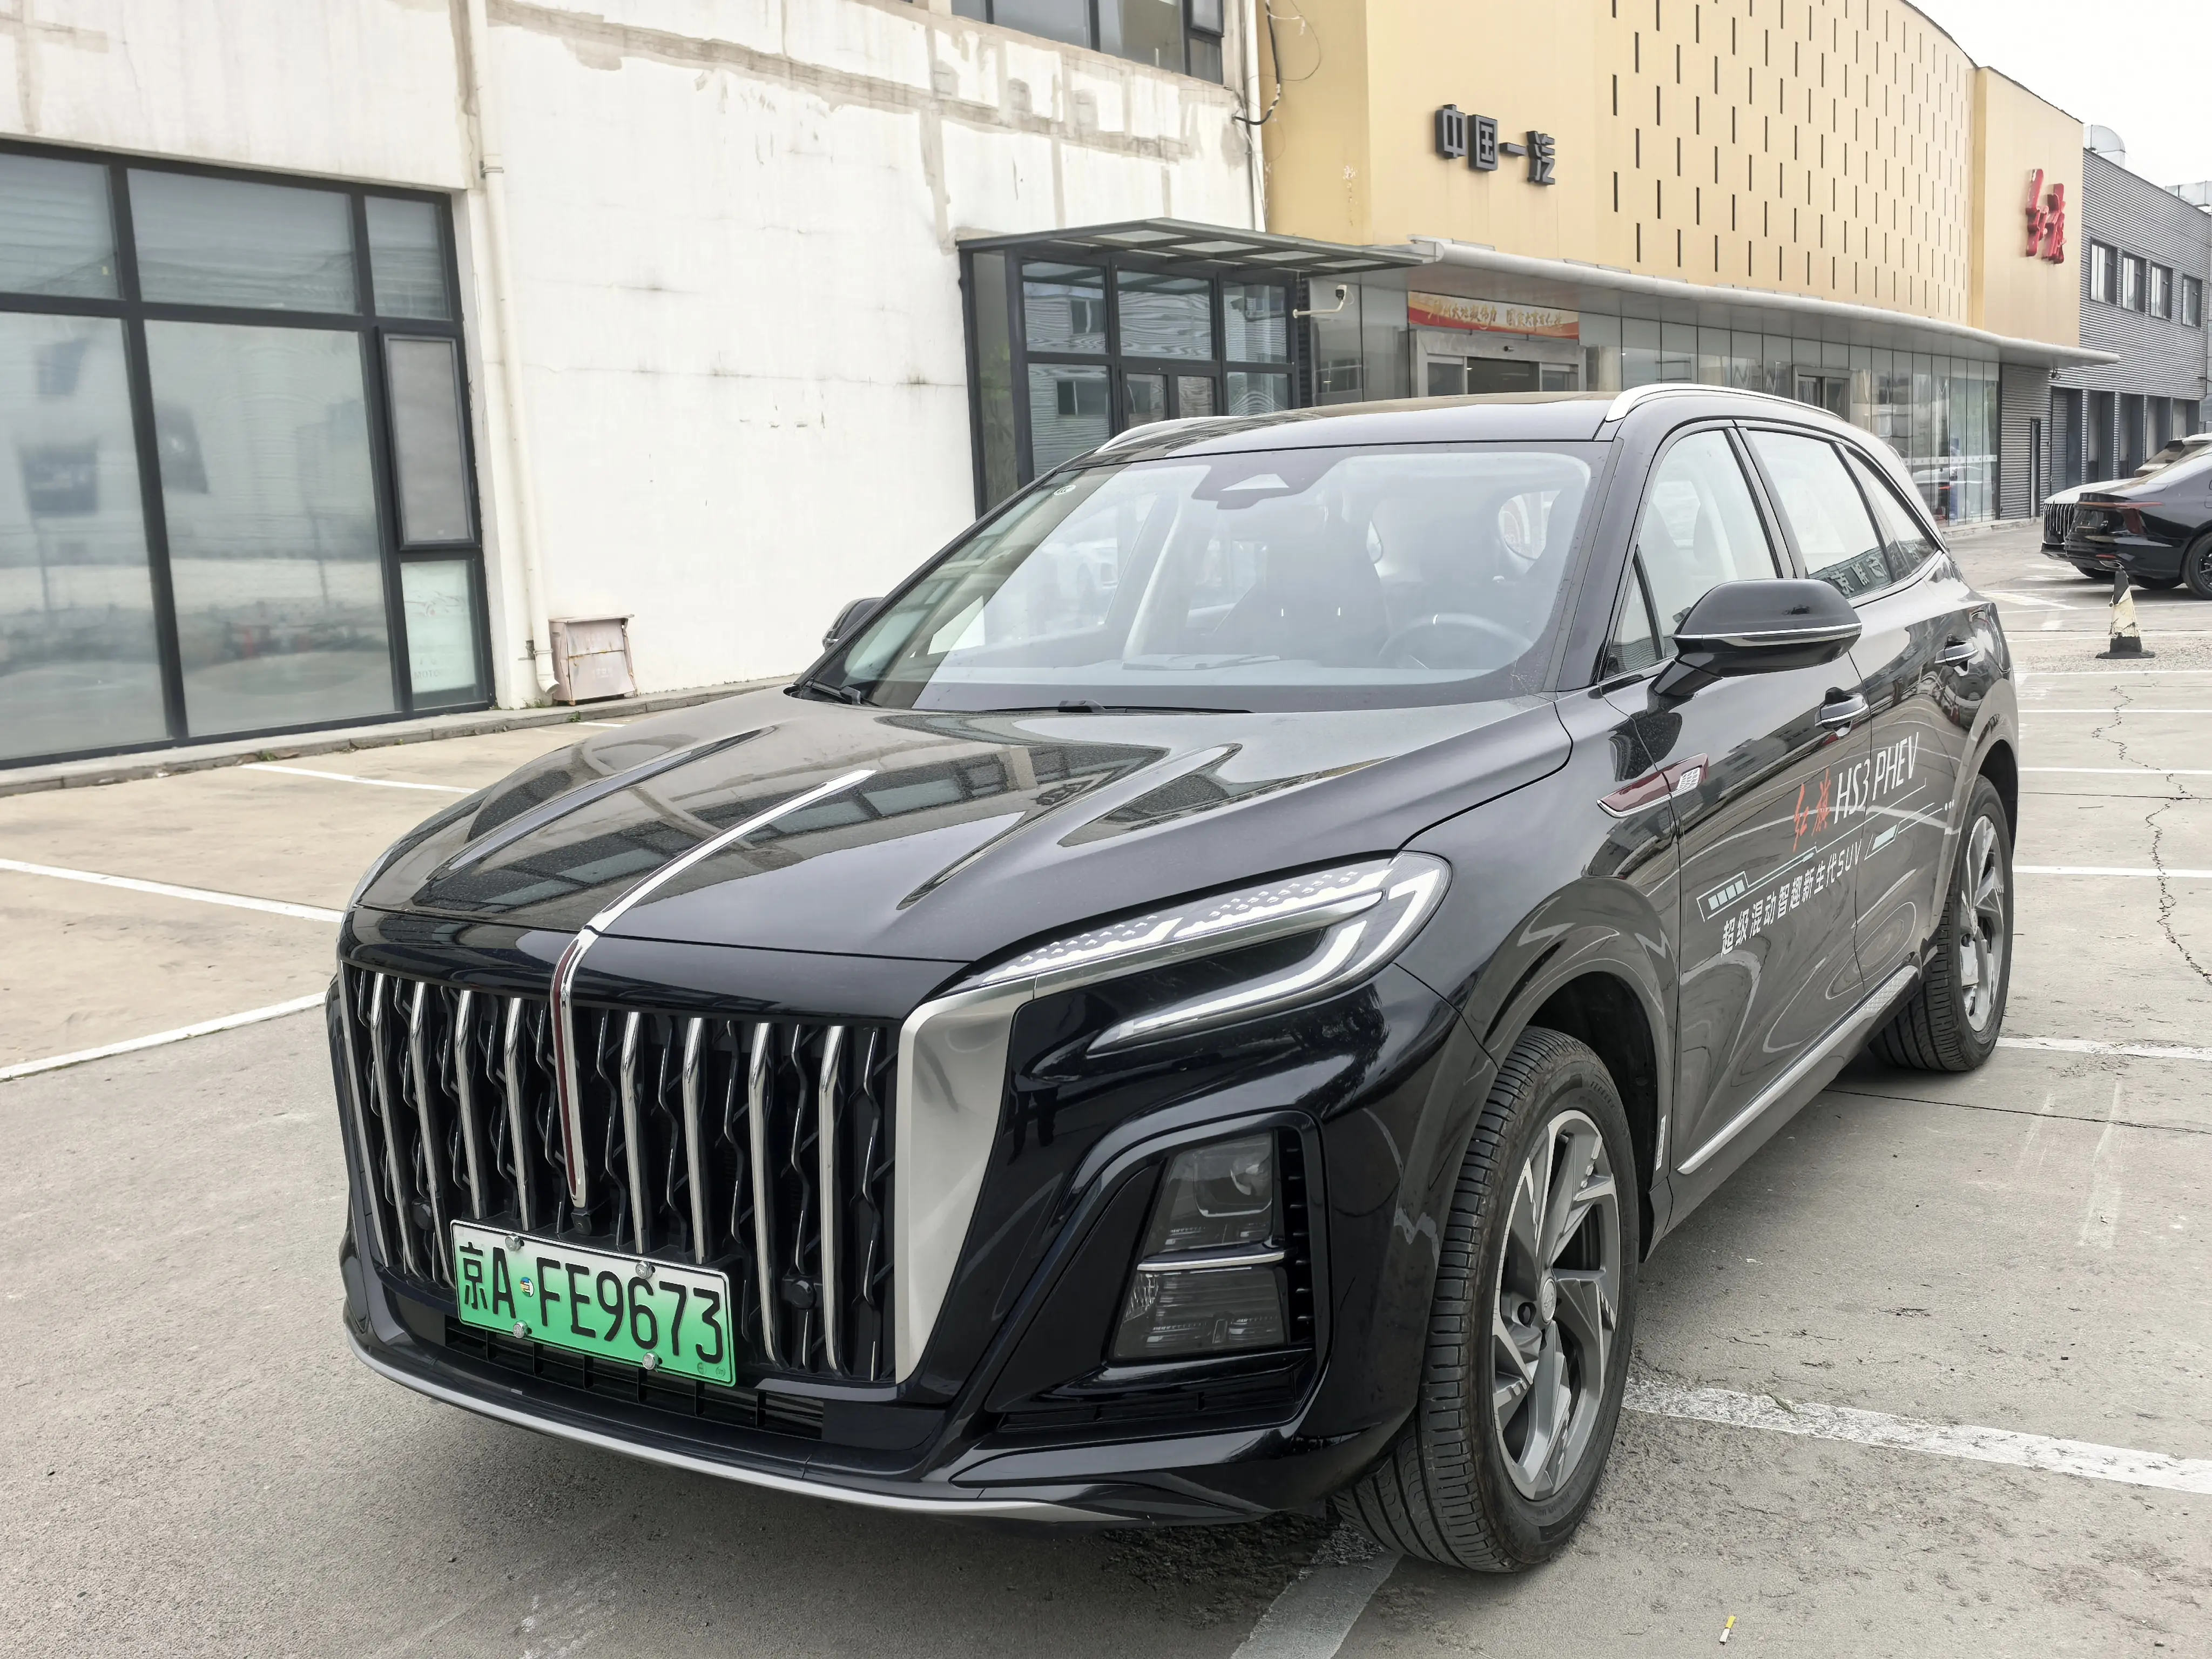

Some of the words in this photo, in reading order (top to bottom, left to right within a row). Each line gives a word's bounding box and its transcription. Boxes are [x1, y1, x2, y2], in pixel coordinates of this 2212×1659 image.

[1435, 104, 1555, 186] 中国一汽
[1792, 767, 1831, 852] 红旗
[1833, 759, 1870, 824] HS3
[1872, 731, 1919, 801] PHEV
[1720, 839, 1863, 957] 超级混动智趣新生代SUV
